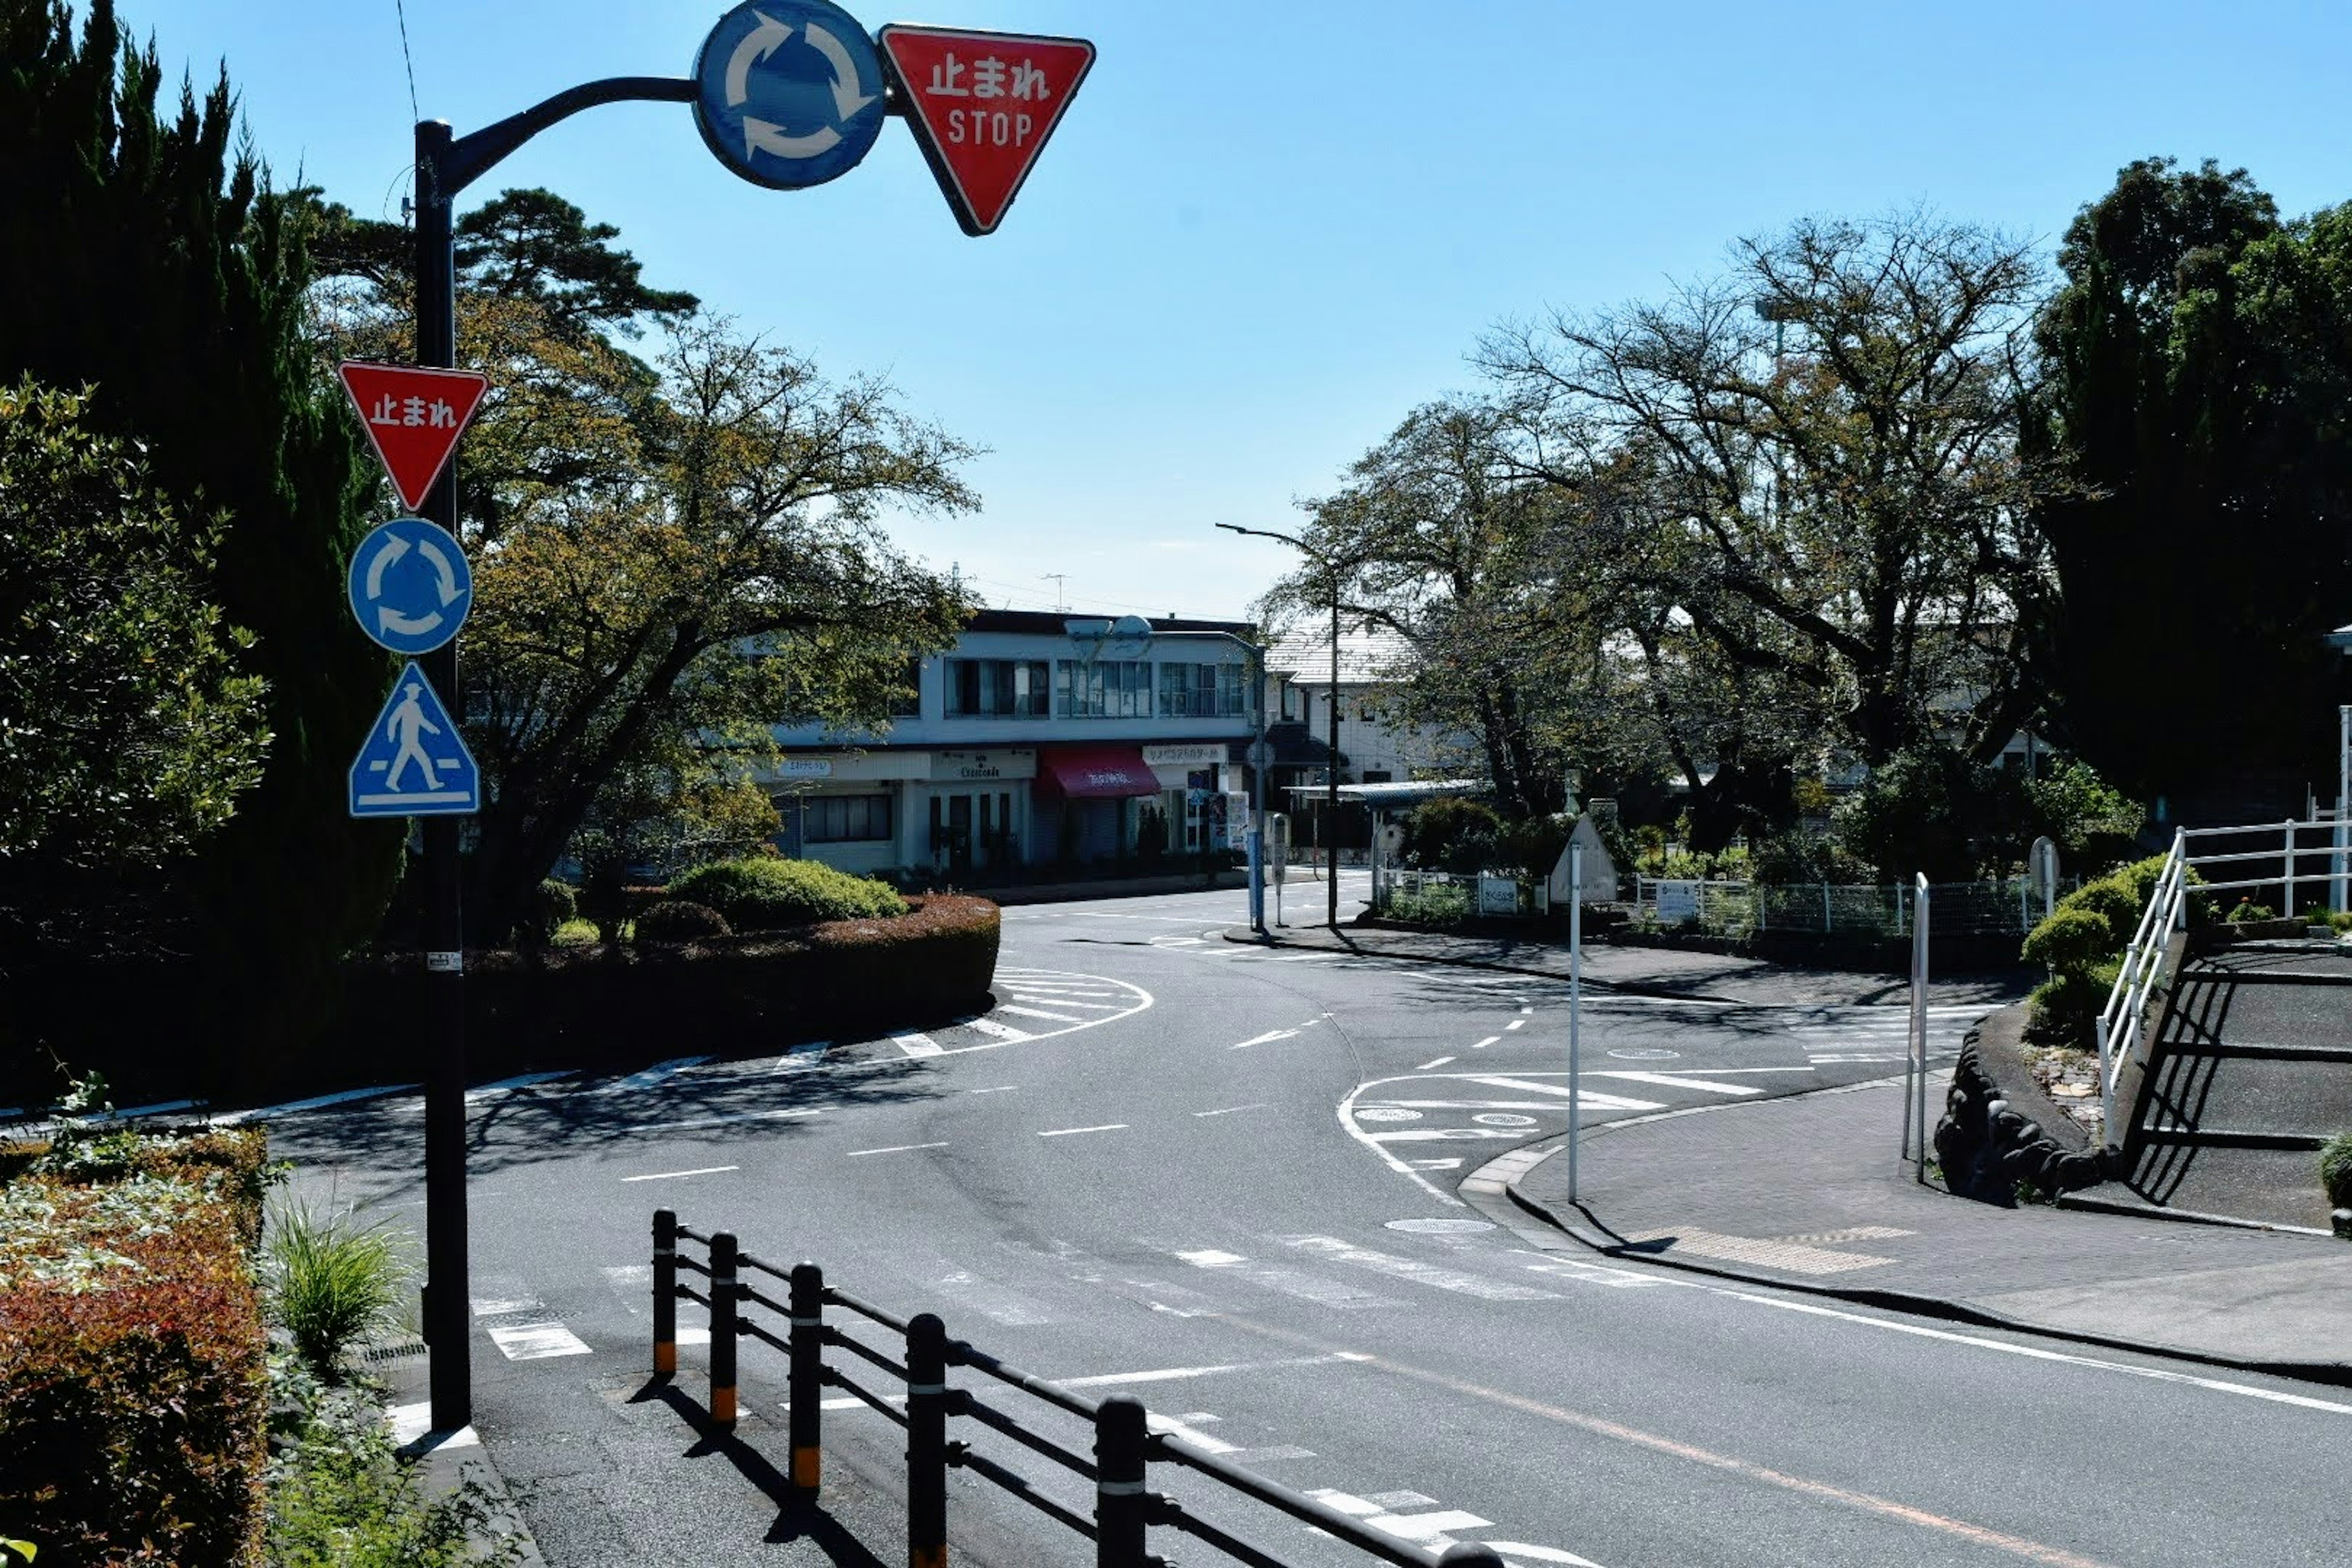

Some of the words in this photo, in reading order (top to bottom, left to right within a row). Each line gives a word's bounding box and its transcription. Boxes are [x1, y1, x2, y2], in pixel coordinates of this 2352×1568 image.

[925, 53, 1051, 102] 止まれ
[948, 108, 1032, 147] STOP
[370, 393, 457, 428] 止まれ
